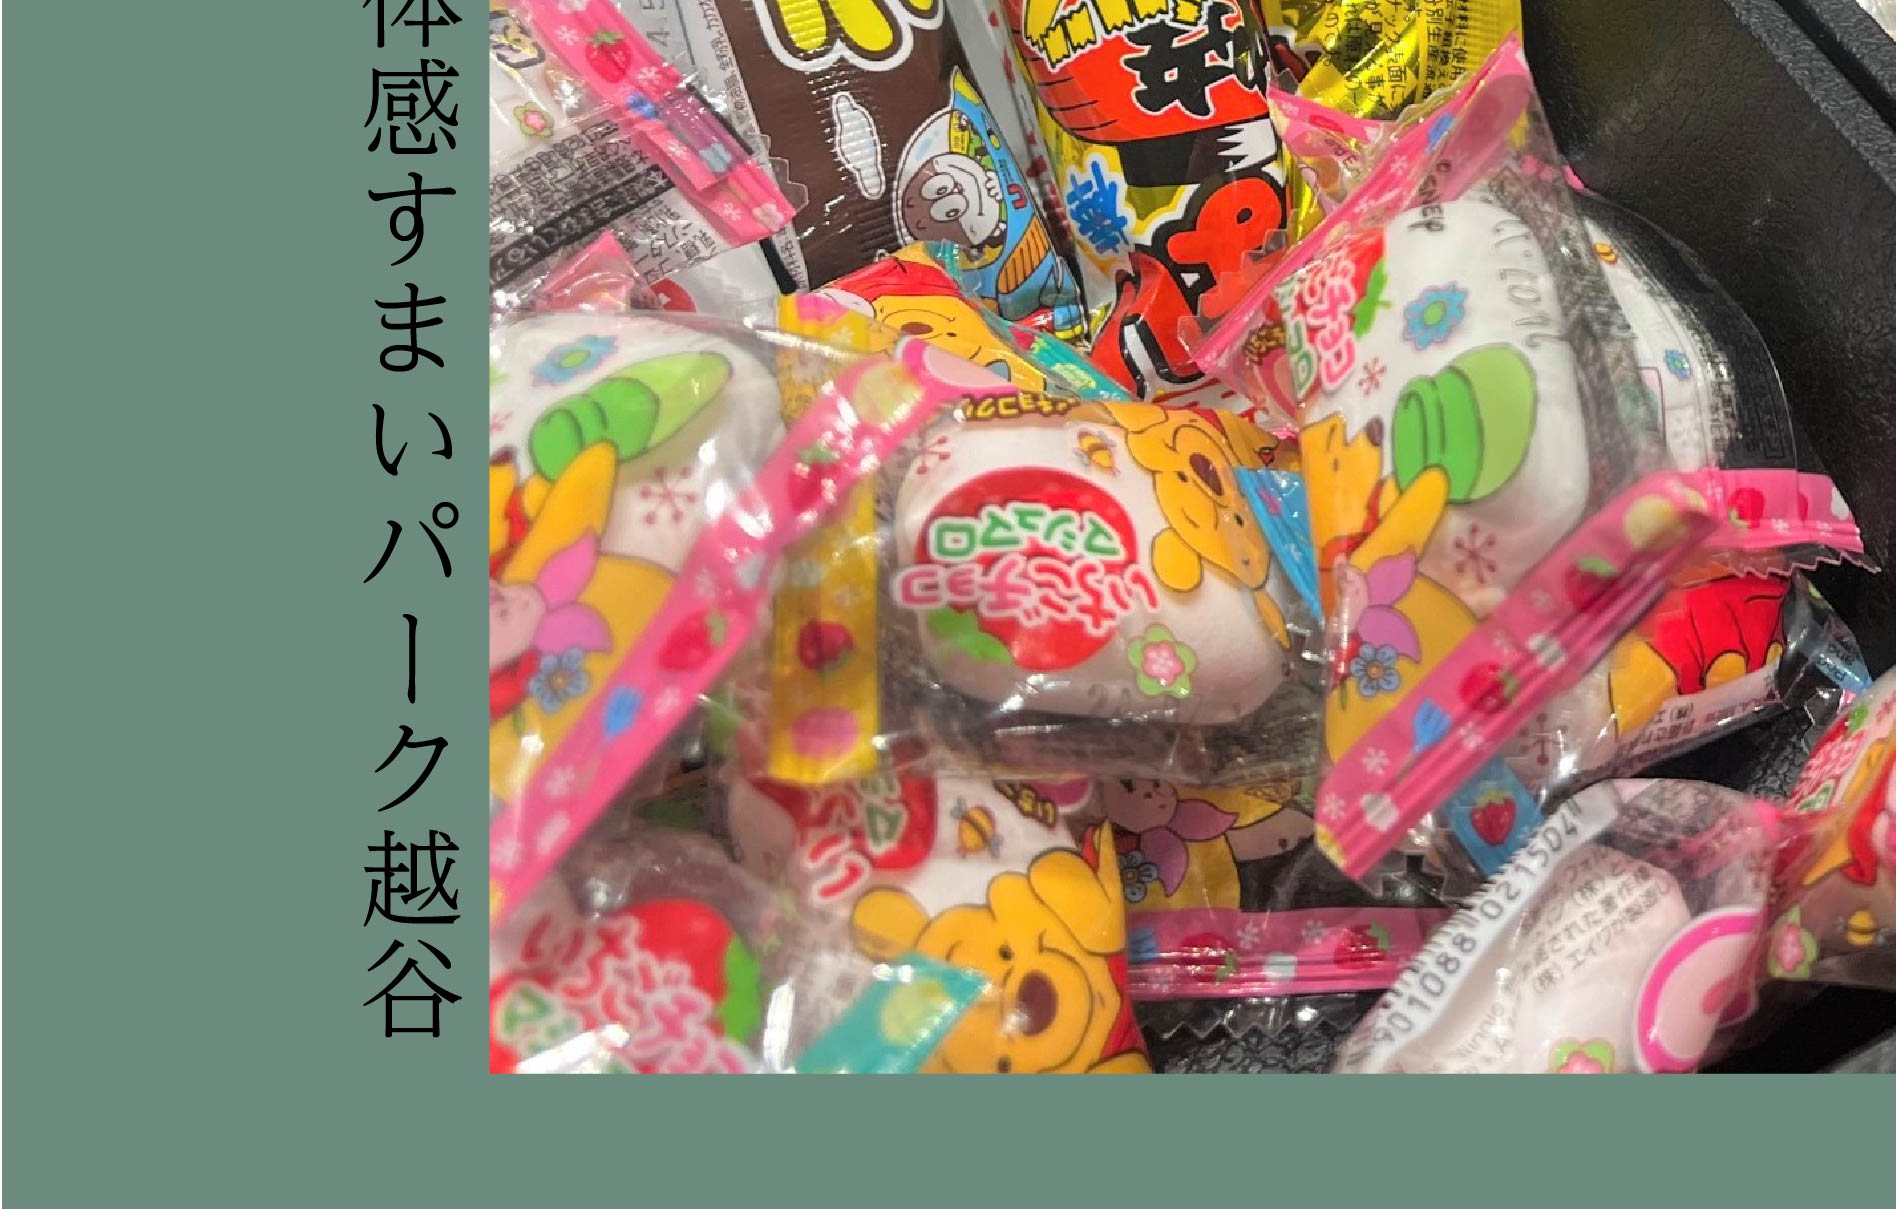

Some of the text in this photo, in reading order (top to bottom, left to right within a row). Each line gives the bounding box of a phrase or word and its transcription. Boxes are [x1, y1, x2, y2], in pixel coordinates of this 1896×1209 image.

[934, 505, 1122, 558] マシュマロ
[897, 553, 1160, 632] いちごチョコ
